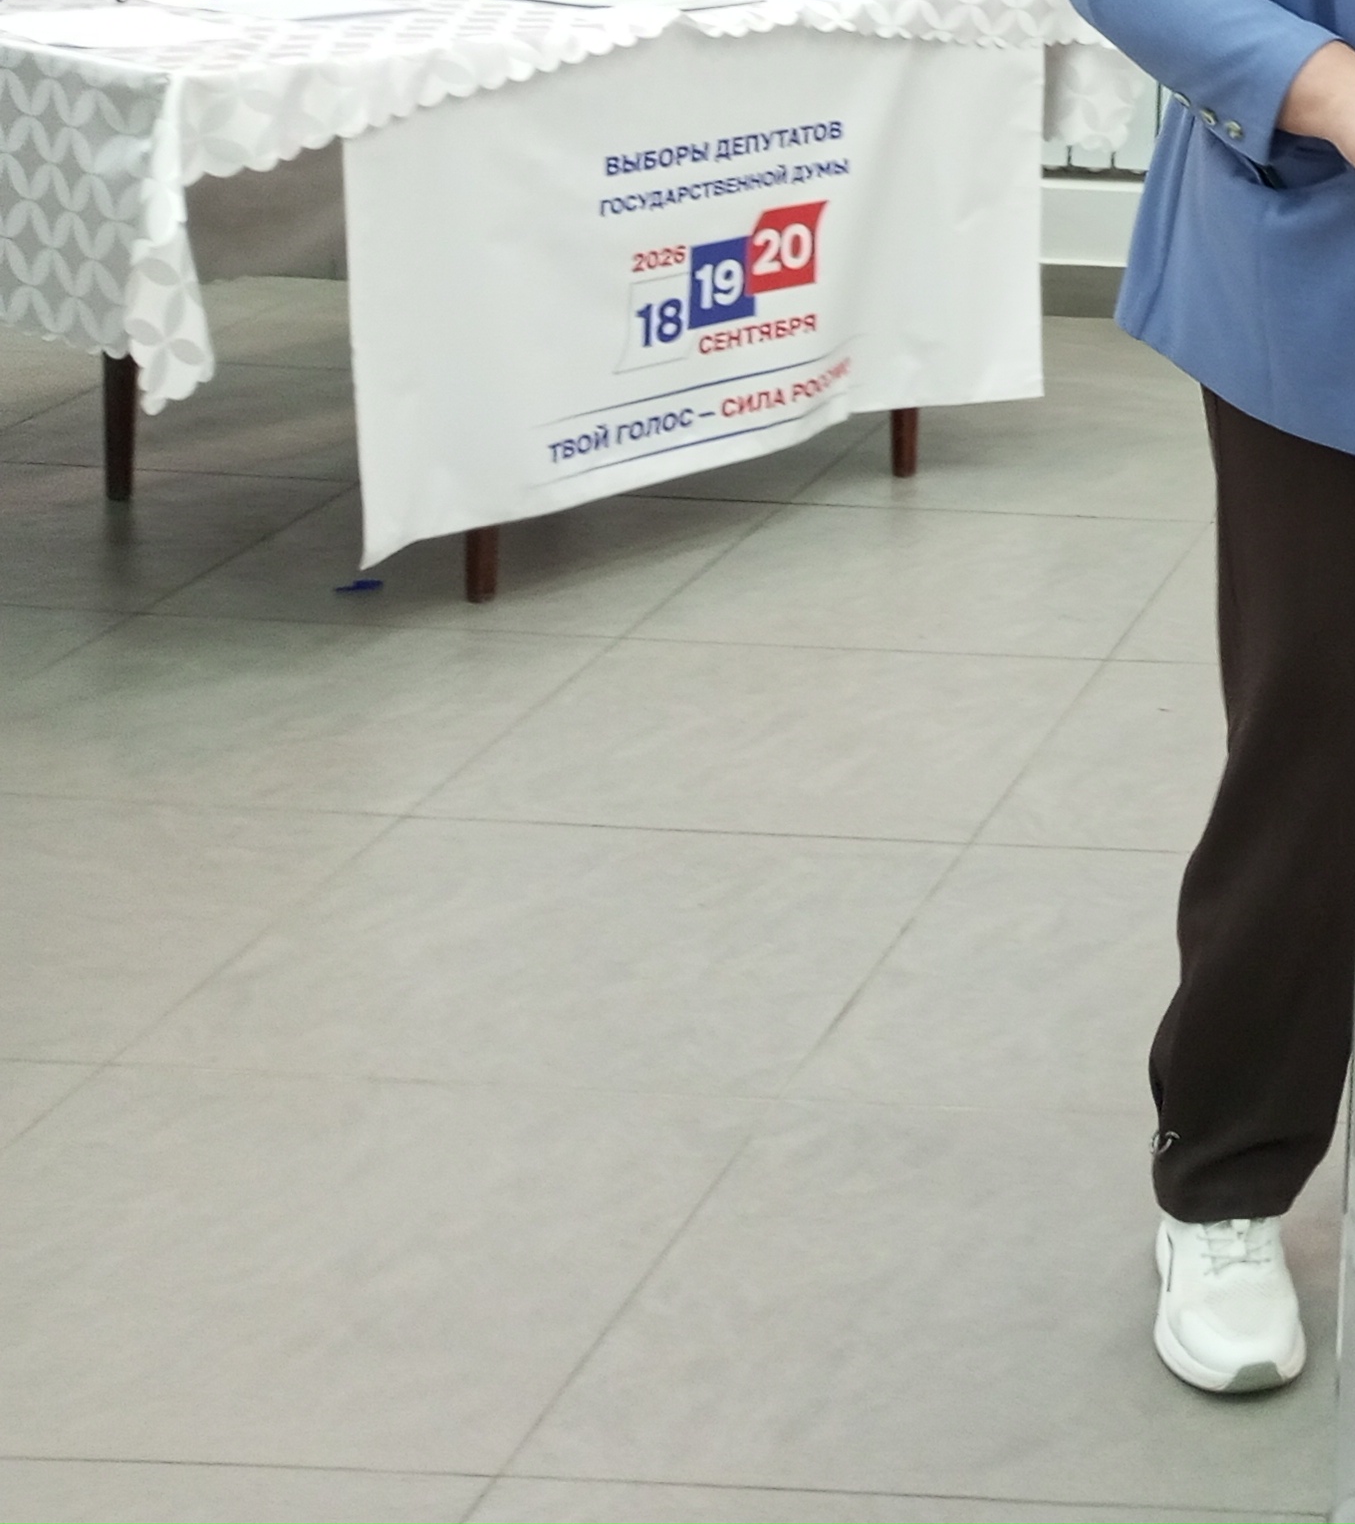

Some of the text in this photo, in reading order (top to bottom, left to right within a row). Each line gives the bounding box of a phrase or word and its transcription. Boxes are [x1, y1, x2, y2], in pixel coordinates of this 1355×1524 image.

[606, 121, 843, 177] ВЫБОРЫ ДЕПУТАТОВ
[600, 159, 850, 216] ГОСУДАРСТВЕННОЙ ДУМЫ
[632, 245, 686, 272] 2026
[636, 223, 813, 347] 18 19 20
[699, 314, 817, 354] СЕНТЯБРЯ
[547, 425, 609, 463] ТВОЙ
[616, 408, 694, 443] ГОЛОС
[721, 388, 785, 418] СИЛА
